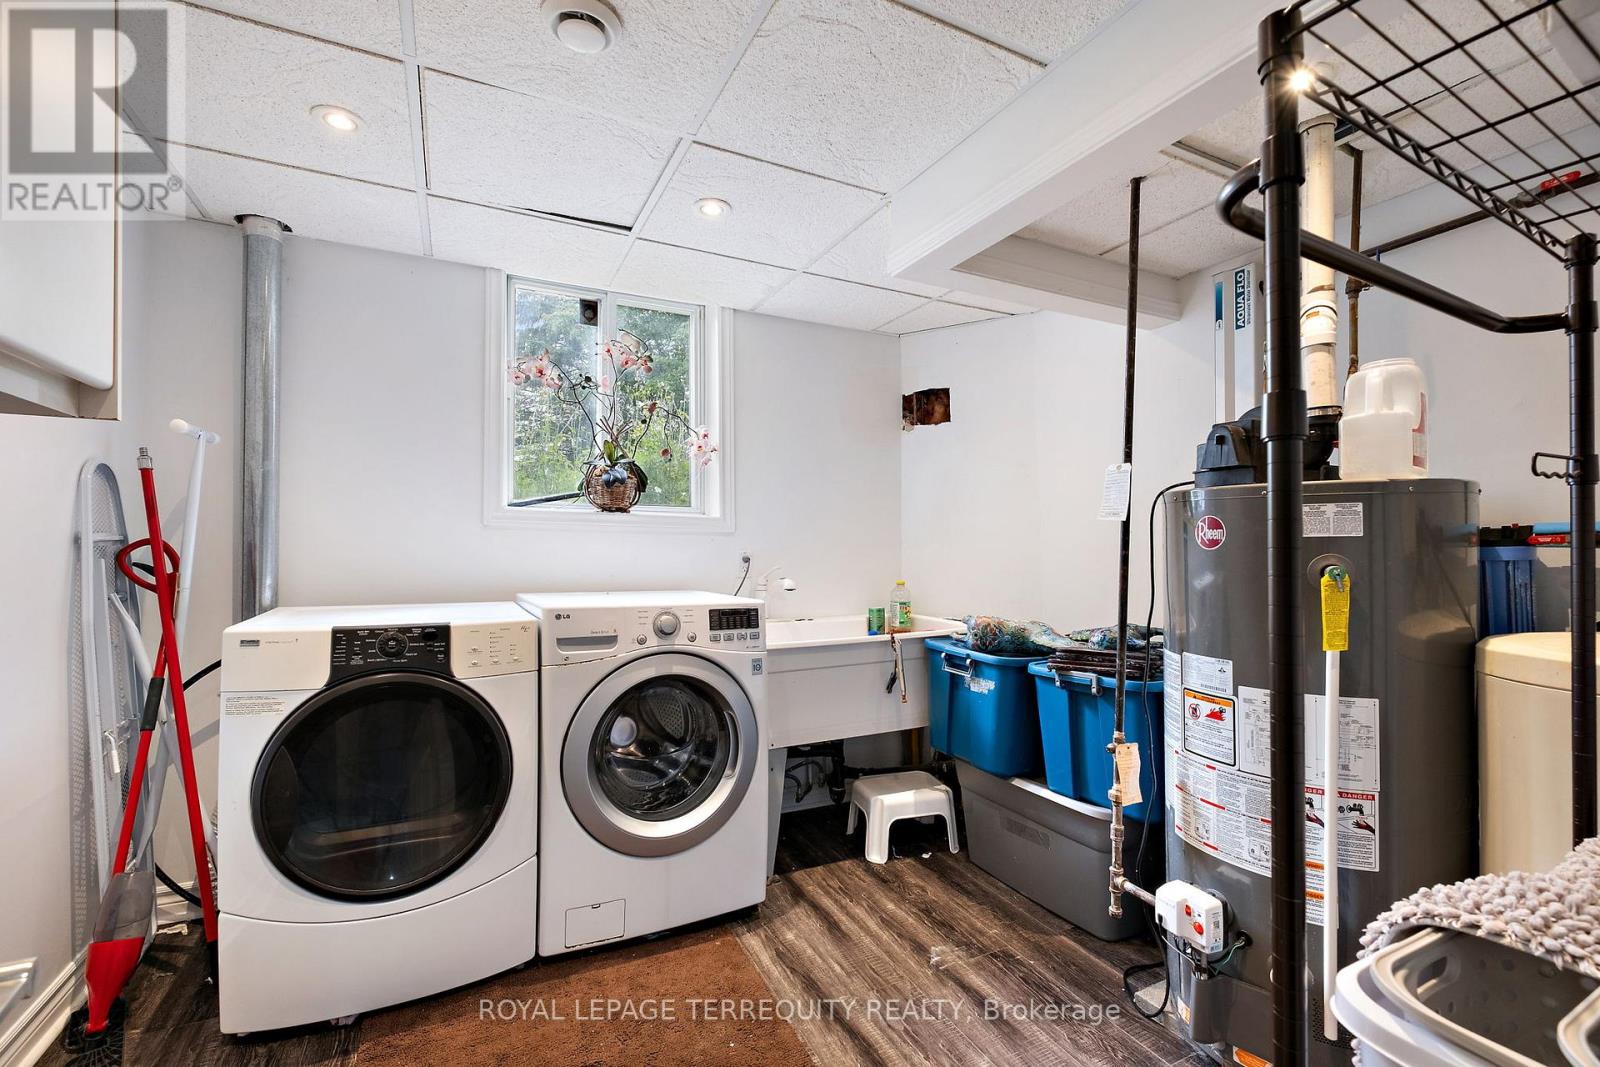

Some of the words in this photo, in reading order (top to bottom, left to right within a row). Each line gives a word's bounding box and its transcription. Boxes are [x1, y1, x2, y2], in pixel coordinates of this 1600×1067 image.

[1237, 272, 1245, 294] FLO
[1237, 295, 1245, 327] AQUA
[1198, 518, 1224, 543] Rheem
